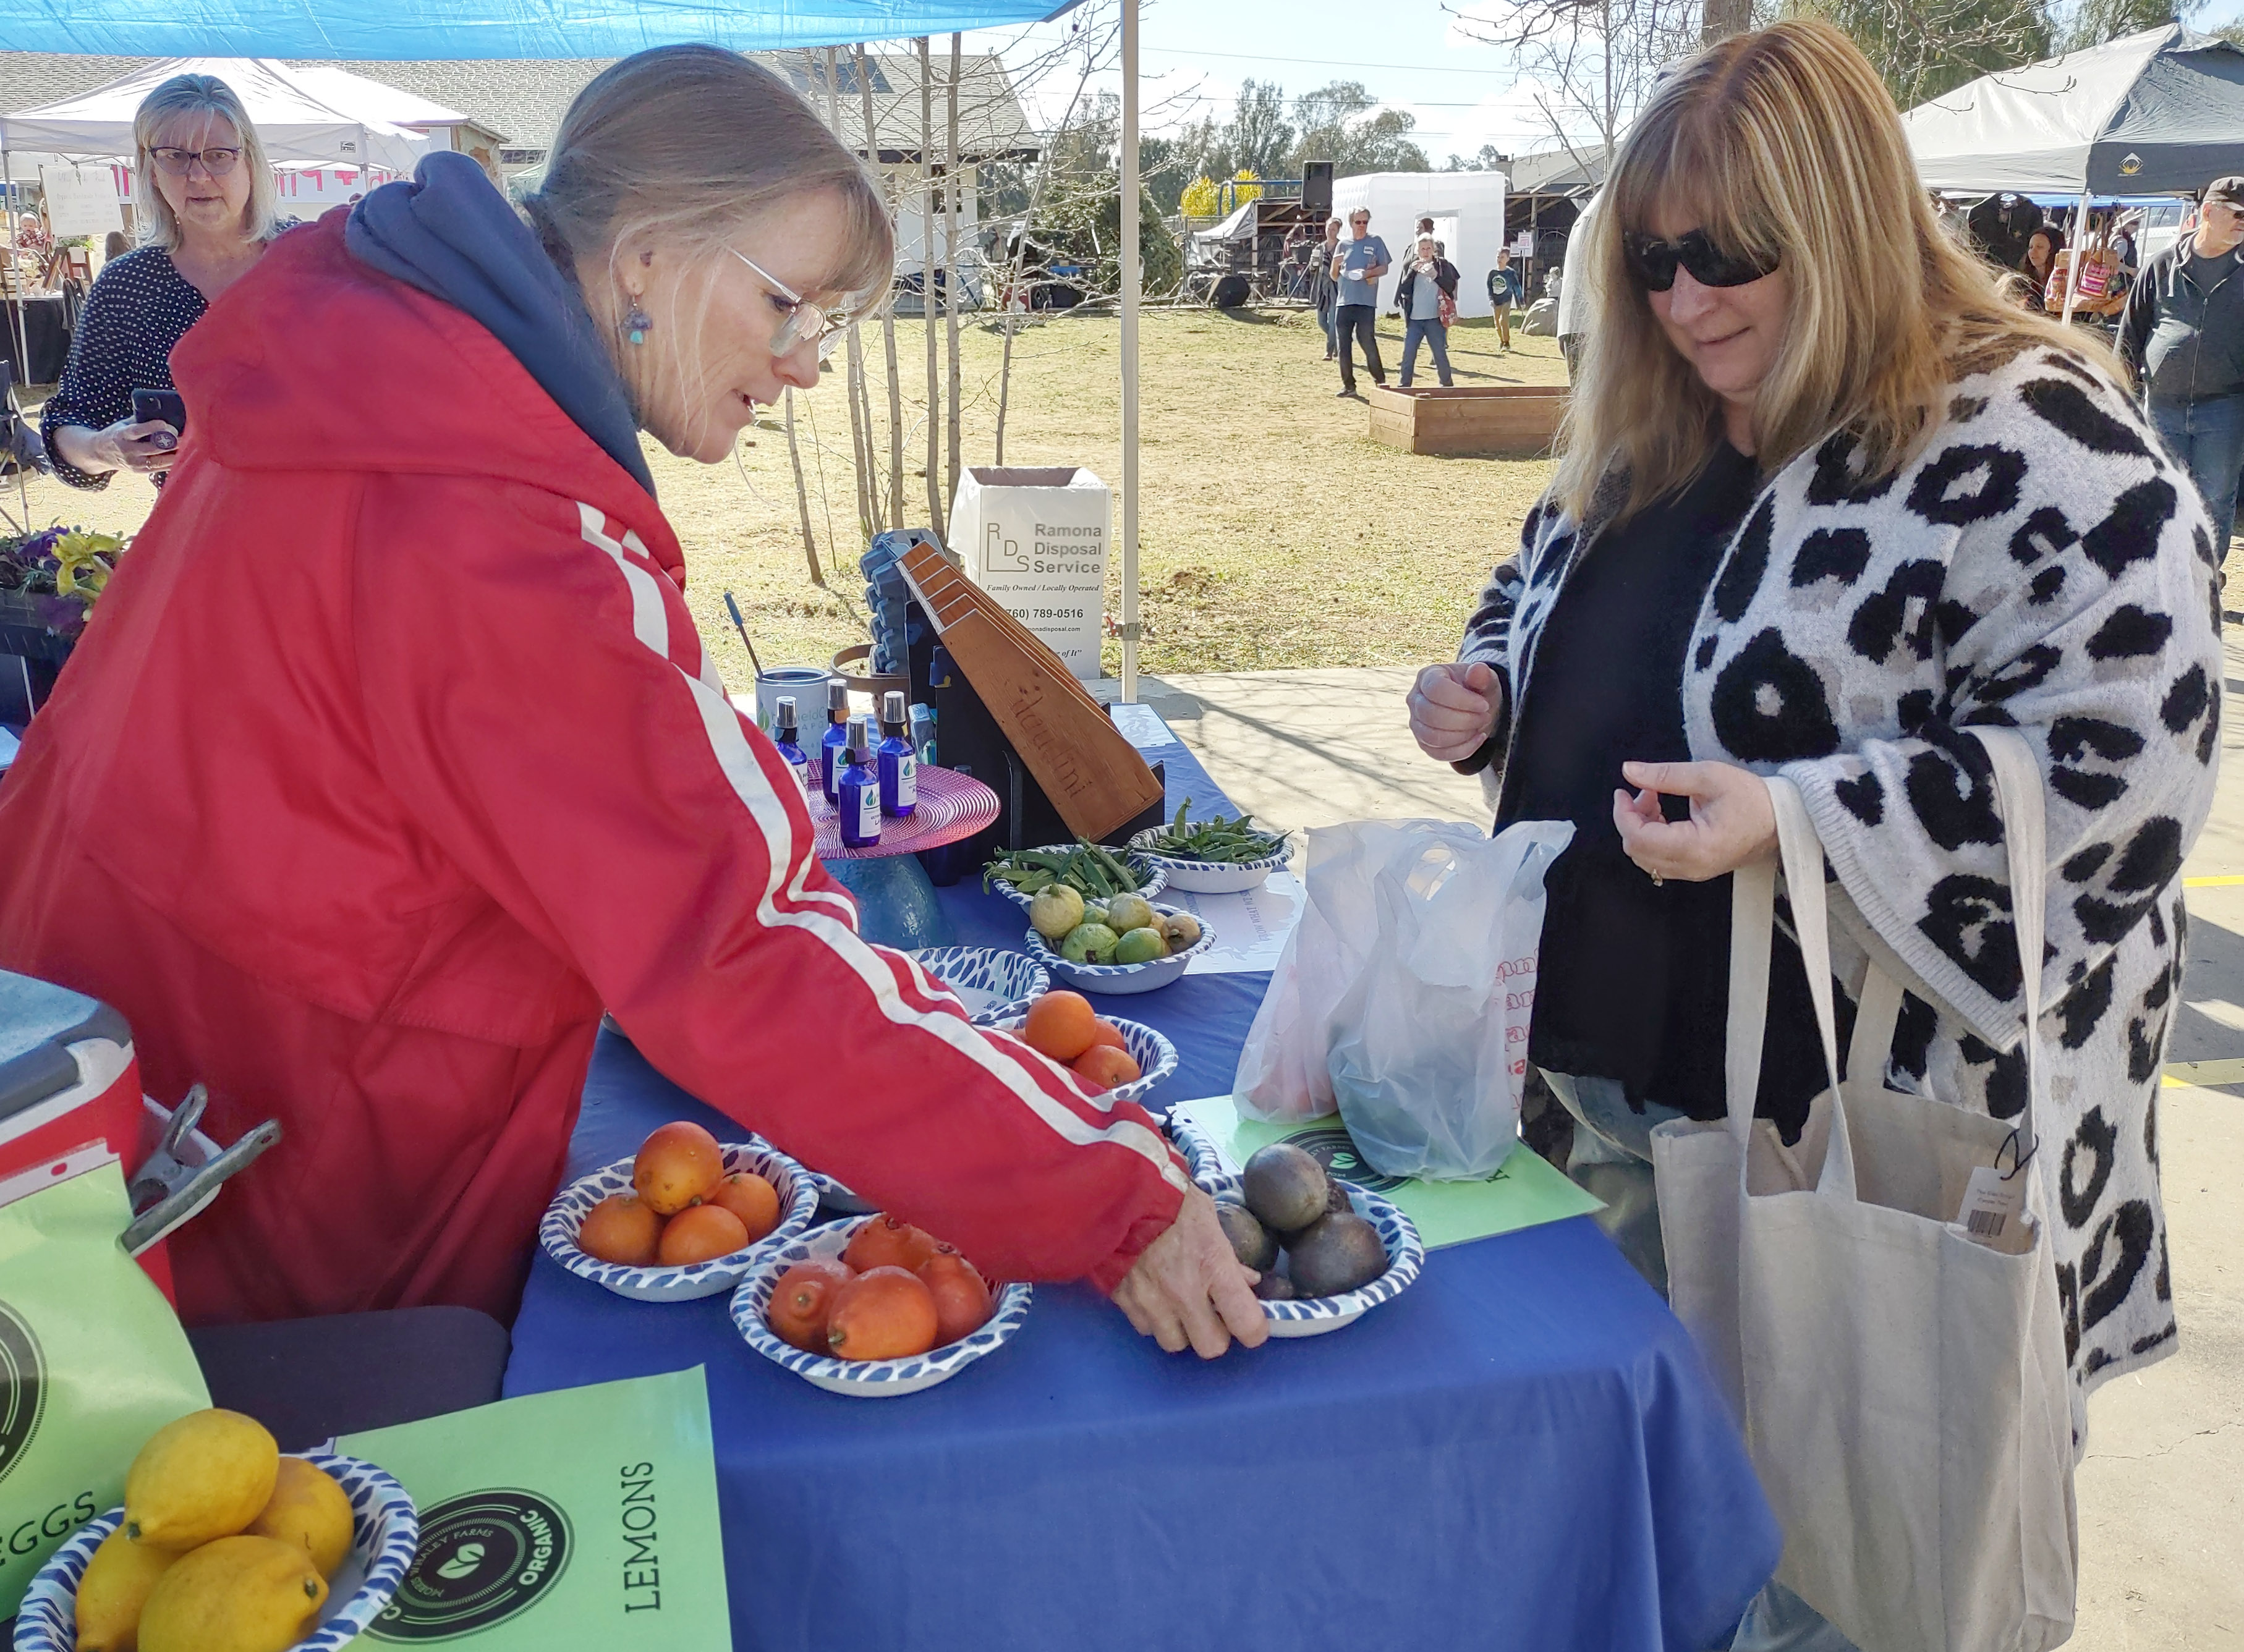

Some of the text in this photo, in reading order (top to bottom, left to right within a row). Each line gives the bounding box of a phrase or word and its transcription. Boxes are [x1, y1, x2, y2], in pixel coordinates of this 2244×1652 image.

[1034, 523, 1102, 538] Ramona
[1034, 541, 1102, 558] Disposal
[1034, 560, 1101, 574] Service
[987, 584, 1011, 593] Family
[1042, 584, 1068, 593] Locally
[1068, 584, 1100, 593] Operated
[1033, 609, 1084, 618] 789-0516
[0, 1491, 96, 1566] GGS
[453, 1528, 494, 1540] FARMS
[620, 1462, 661, 1613] LEMONS
[518, 1510, 553, 1586] ORGANIC
